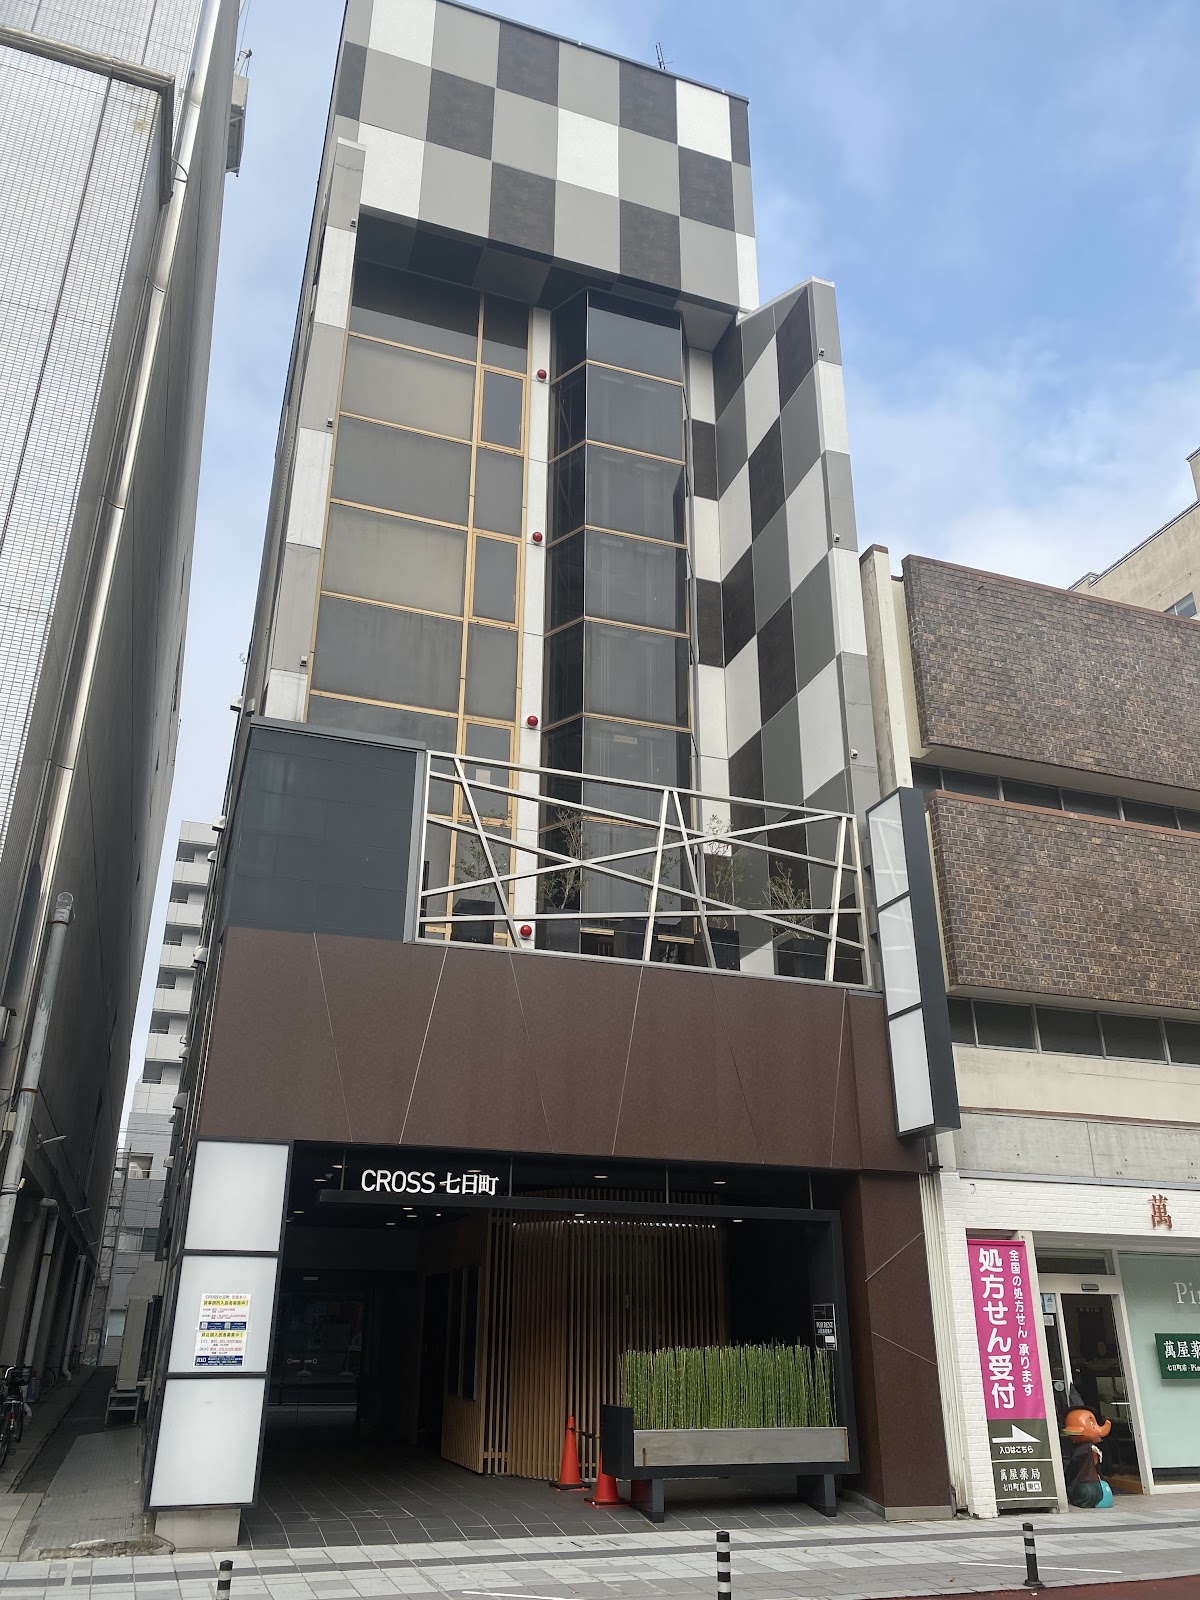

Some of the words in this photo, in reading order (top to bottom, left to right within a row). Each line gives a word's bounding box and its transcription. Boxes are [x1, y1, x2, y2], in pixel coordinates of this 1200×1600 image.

[361, 1169, 436, 1194] CROSS
[439, 1172, 500, 1196] 七日町
[1148, 1193, 1173, 1231] 萬
[1009, 1249, 1028, 1338] 全国の処方せん
[978, 1248, 1016, 1410] 処方せん受付
[1018, 1343, 1035, 1397] 承ります
[999, 1445, 1034, 1455] 入口はこちら
